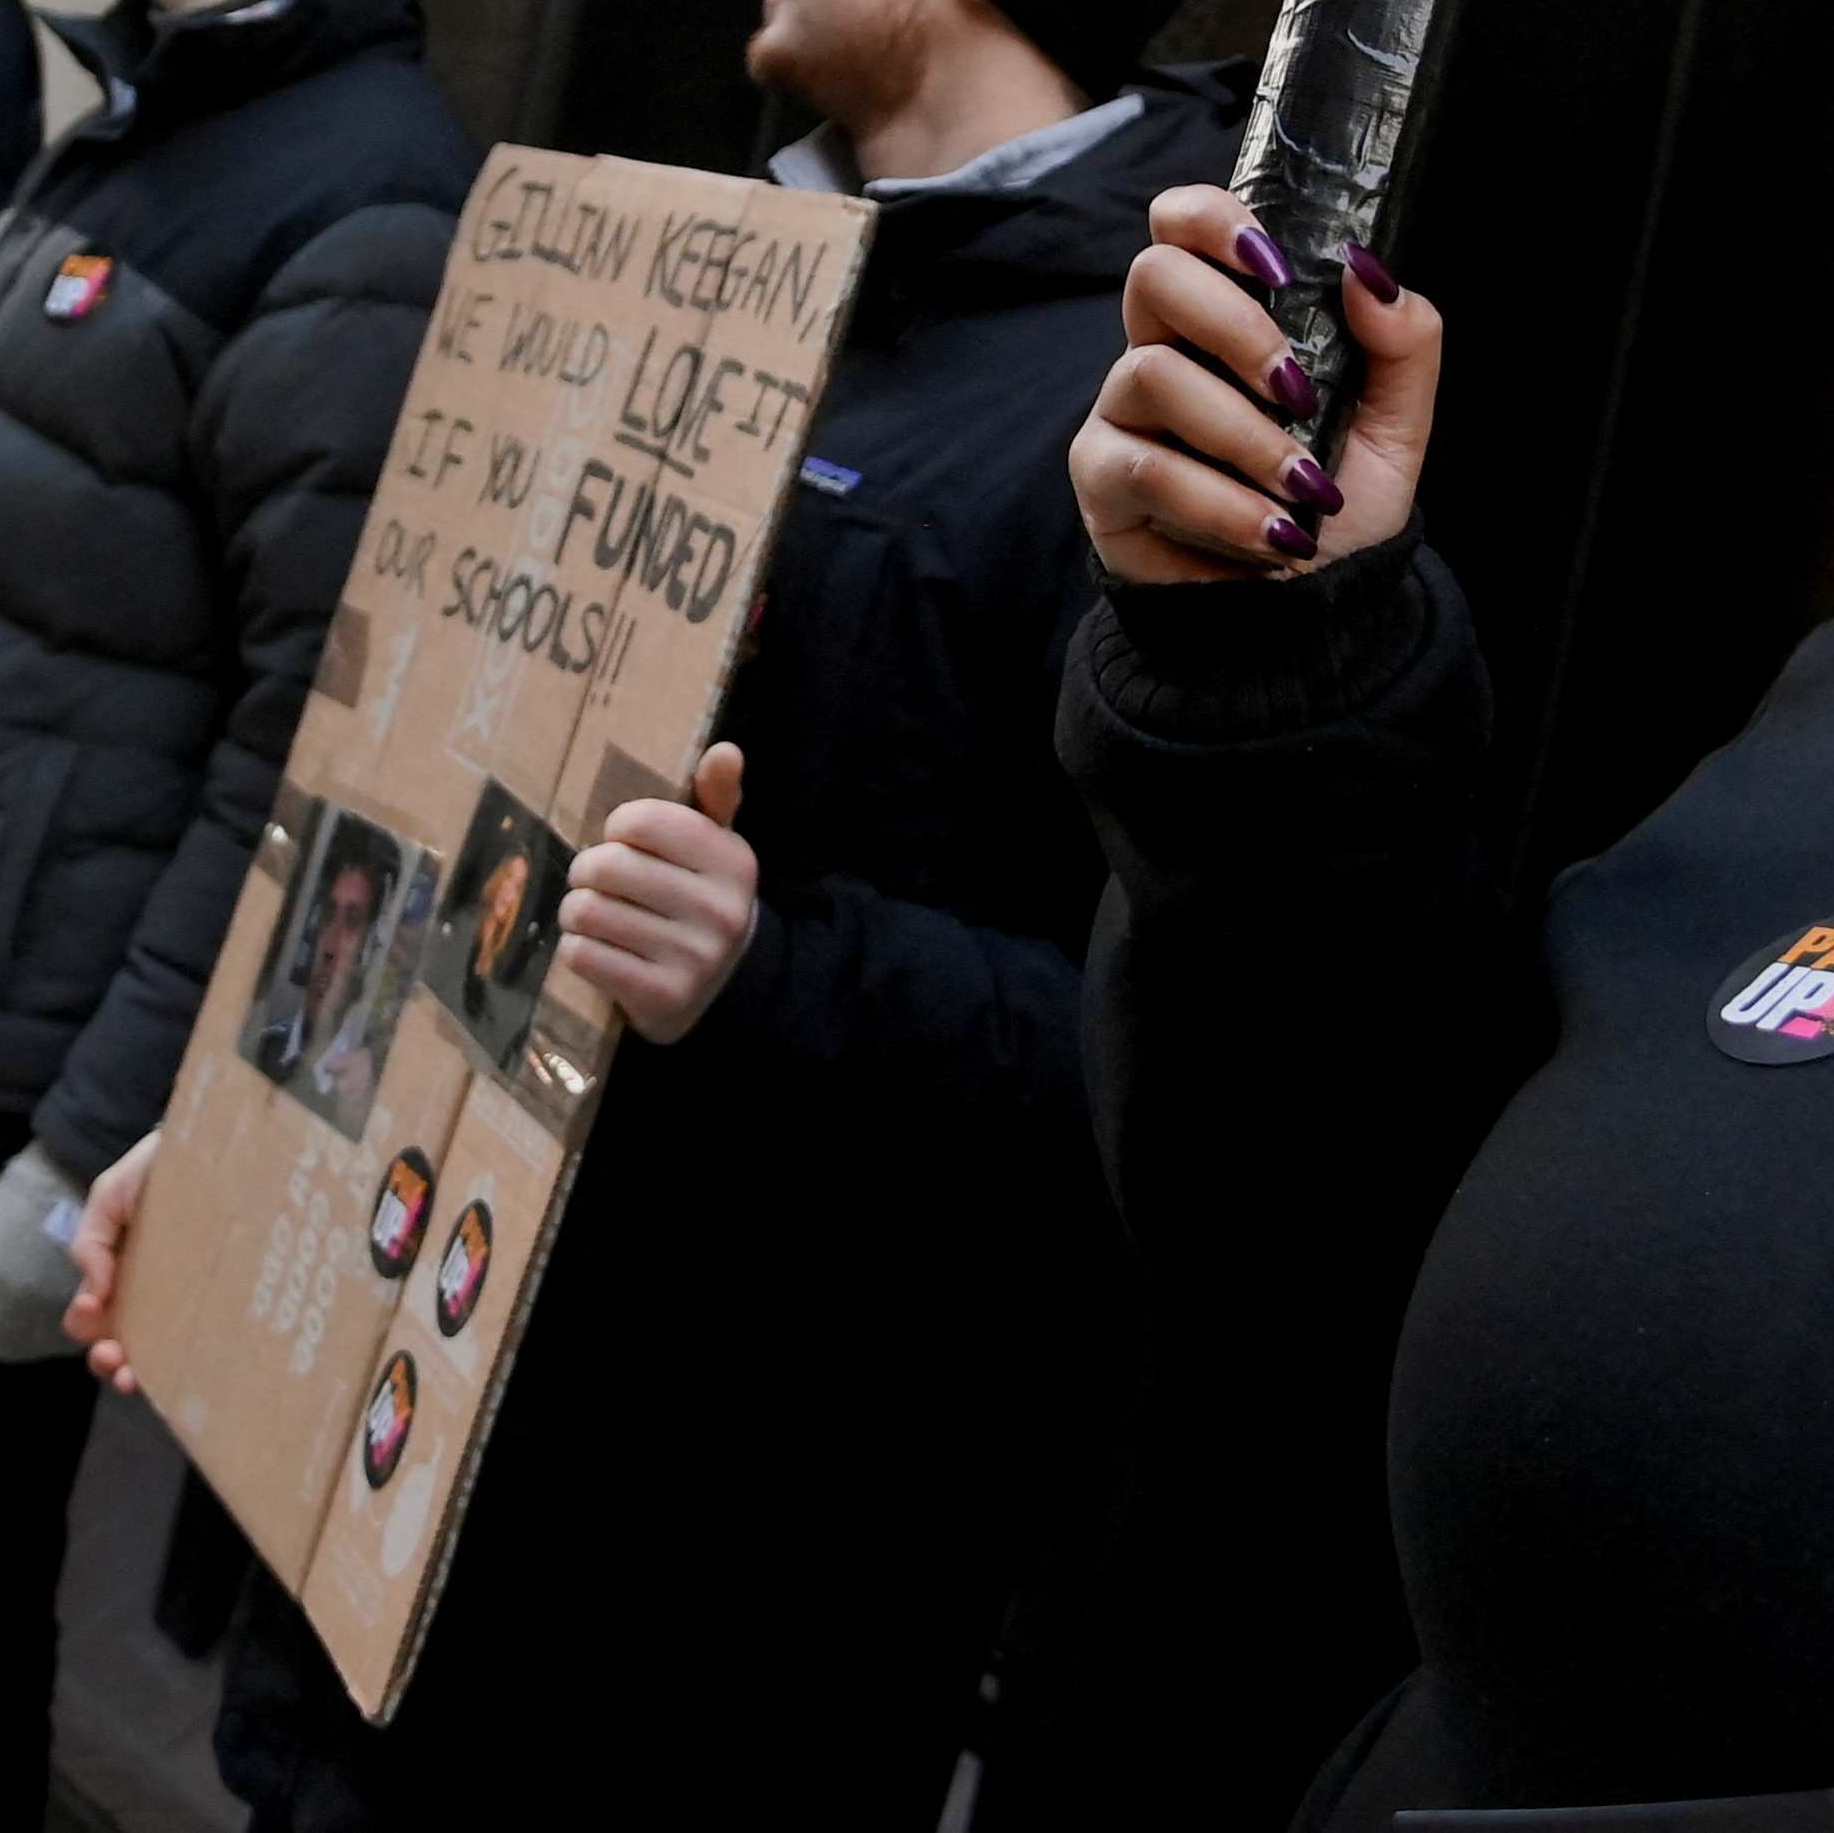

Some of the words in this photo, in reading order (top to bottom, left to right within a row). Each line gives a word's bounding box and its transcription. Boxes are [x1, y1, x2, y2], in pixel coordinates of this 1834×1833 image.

[642, 210, 829, 344] KEEGAN,
[433, 283, 496, 366] WE
[498, 301, 610, 388] WOULD
[618, 323, 746, 465] LOVE
[733, 368, 810, 453] IT
[373, 516, 438, 598] OUR
[405, 406, 476, 494] IF
[475, 430, 545, 510] YOU
[552, 456, 738, 625] FUNDED
